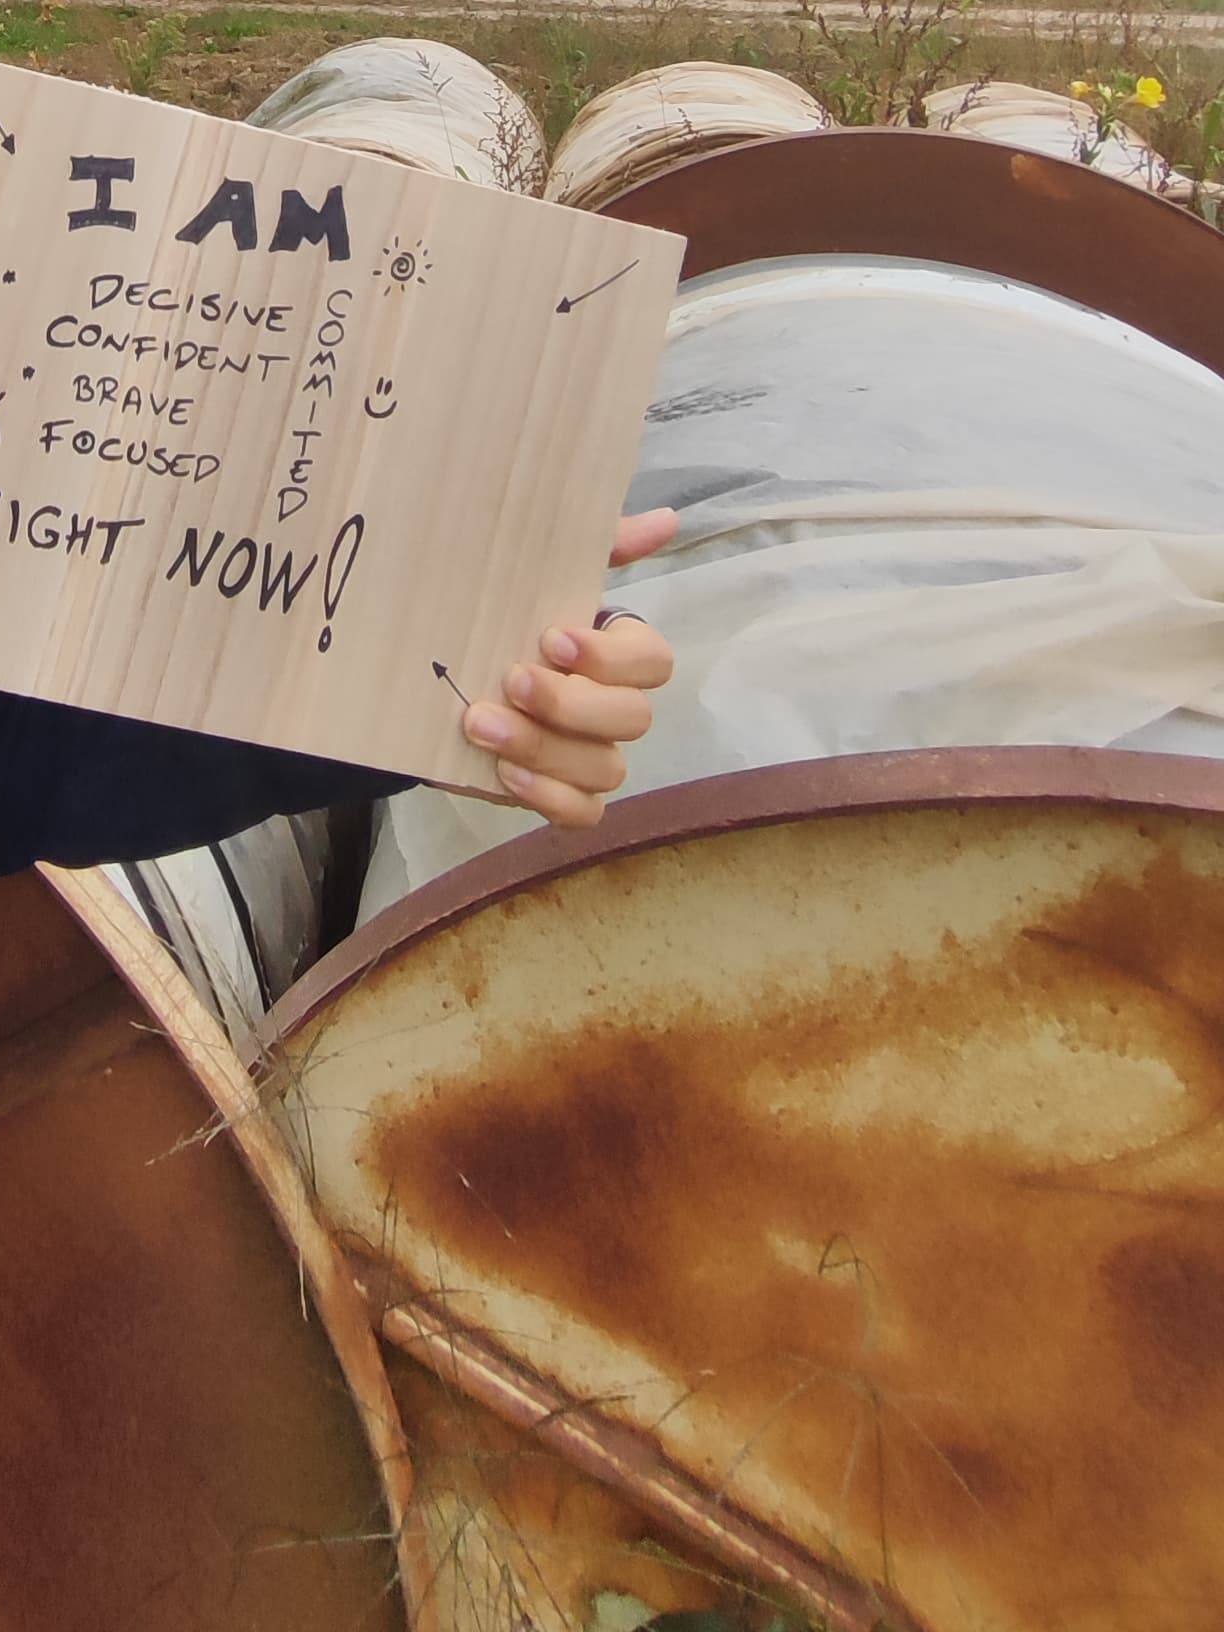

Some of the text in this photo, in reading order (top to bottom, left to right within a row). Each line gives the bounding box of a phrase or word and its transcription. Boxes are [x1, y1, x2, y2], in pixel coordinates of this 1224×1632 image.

[67, 154, 351, 263] I AM
[89, 274, 294, 333] DECISIVE
[45, 314, 290, 382] CONFIDENT
[72, 374, 194, 426] BRAVE
[39, 419, 221, 484] FOCUSED
[165, 513, 365, 654] NOW!
